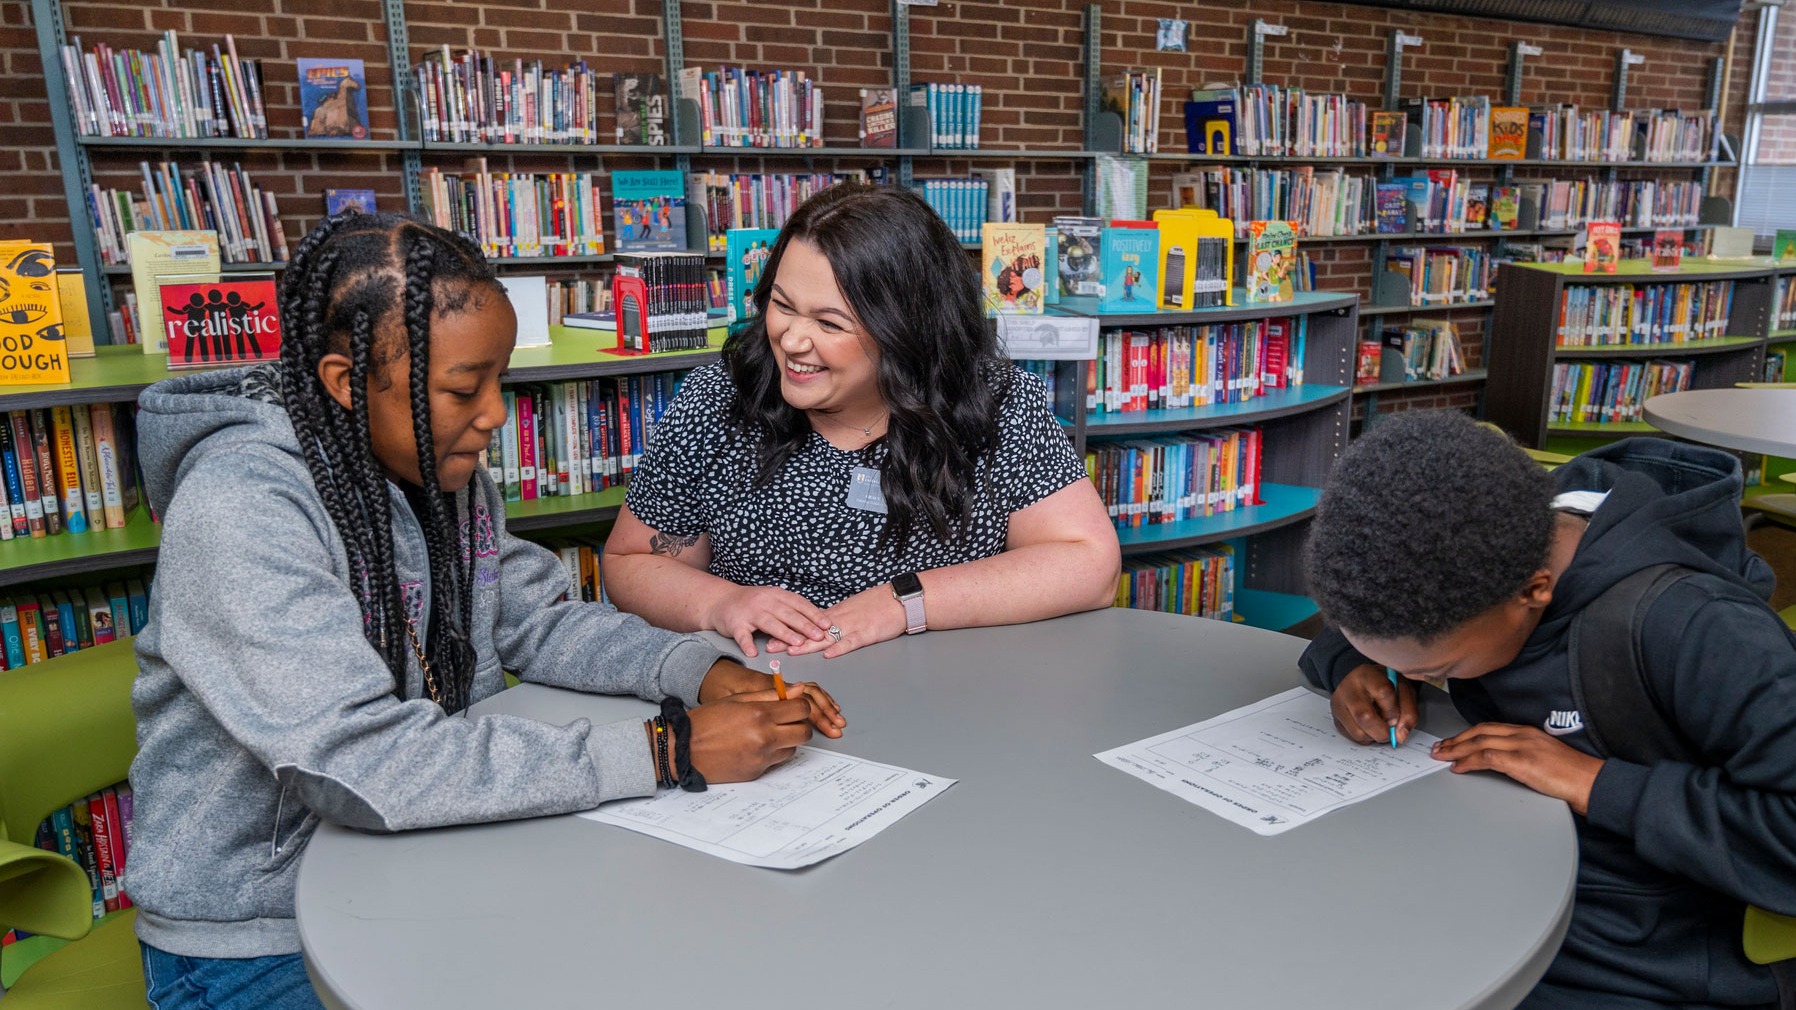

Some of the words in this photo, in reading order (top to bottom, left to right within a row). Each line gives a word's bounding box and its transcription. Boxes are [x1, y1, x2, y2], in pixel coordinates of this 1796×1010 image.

[645, 94, 664, 146] SPIES
[867, 123, 896, 135] KILLER
[1002, 241, 1036, 256] Explains
[1111, 239, 1153, 252] POSITIVELY
[167, 309, 278, 339] realistic
[60, 429, 74, 468] HONESTLY
[21, 459, 35, 492] Hidden
[9, 635, 19, 654] One
[28, 627, 39, 651] EVERY
[890, 790, 911, 804] ORDER
[1181, 779, 1223, 799] OPERATIONS
[92, 813, 105, 833] ZARA
[844, 807, 883, 831] OPERATIONS
[95, 833, 111, 863] HOSSAIN
